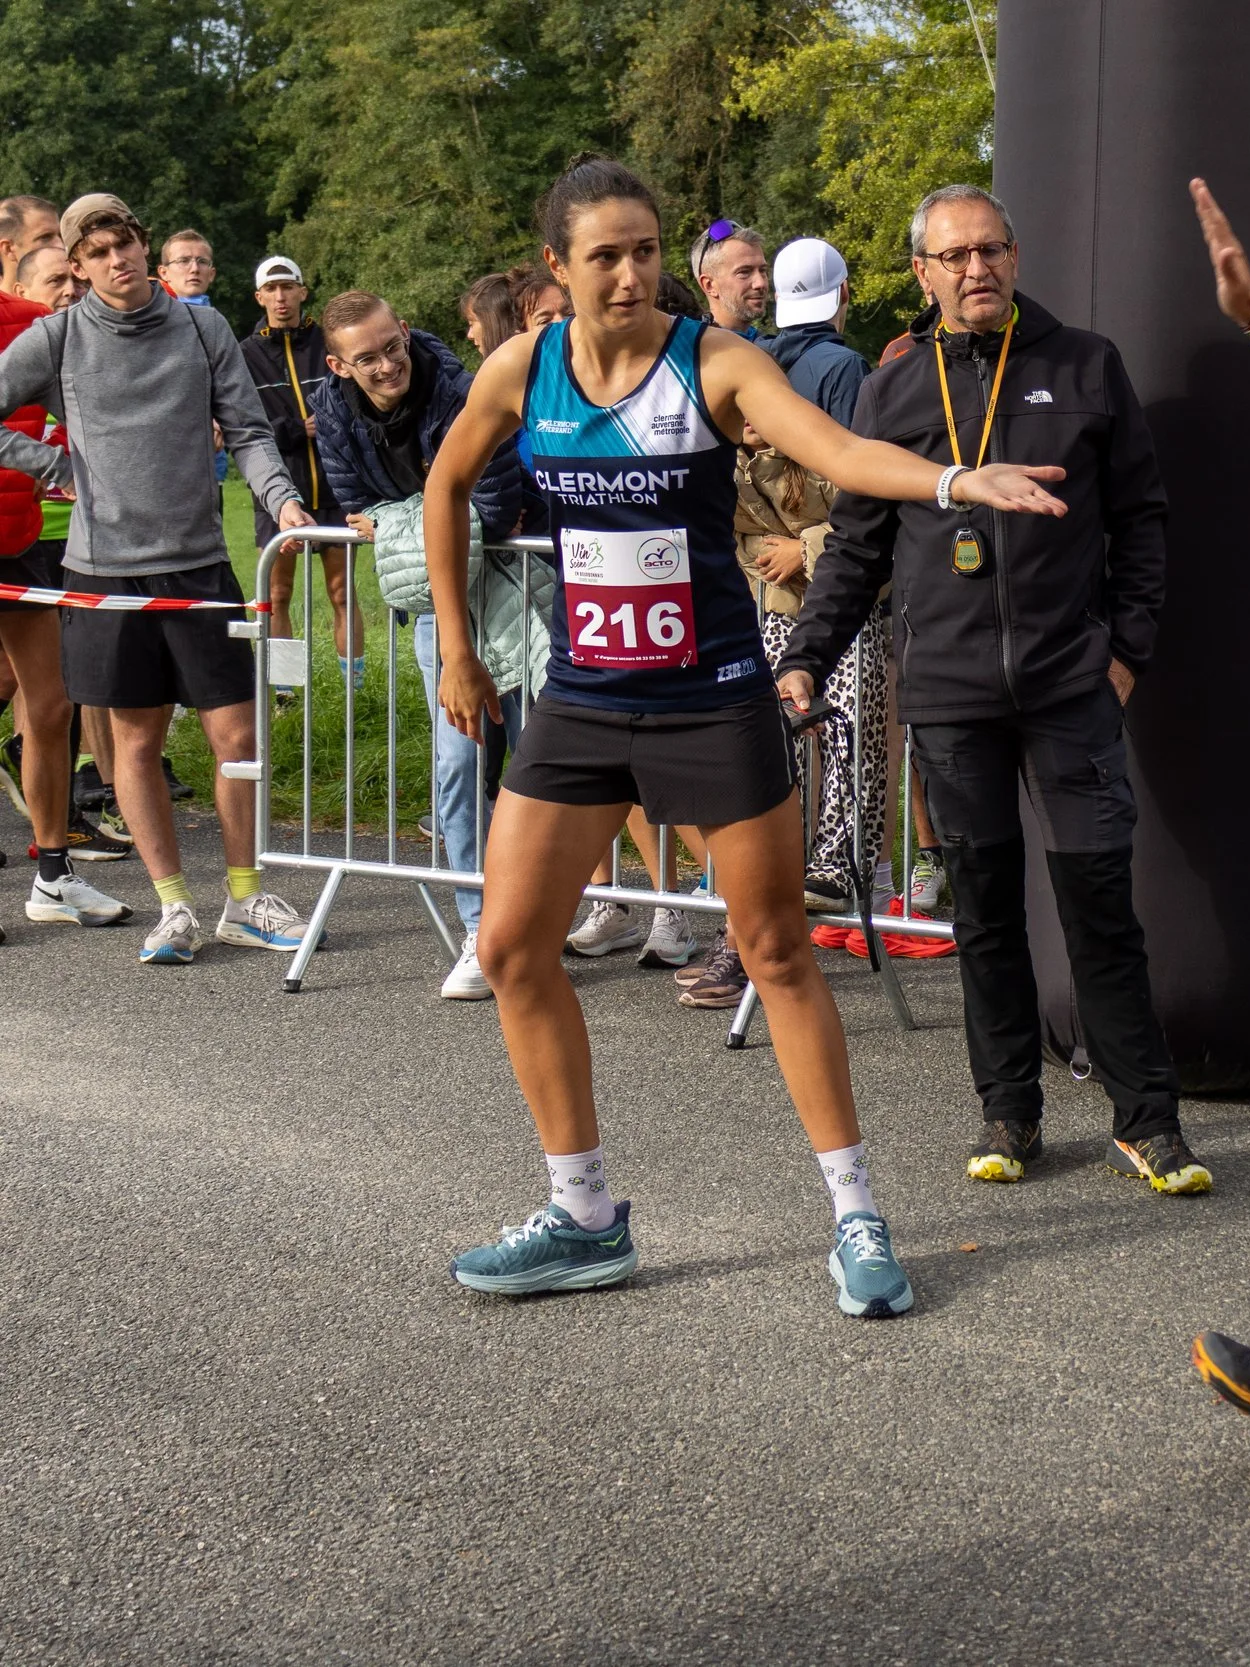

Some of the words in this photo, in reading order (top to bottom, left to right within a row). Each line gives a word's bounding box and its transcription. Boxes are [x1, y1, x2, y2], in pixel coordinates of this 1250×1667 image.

[653, 413, 686, 422] clermont
[545, 420, 580, 429] CLERMONT
[651, 420, 684, 429] auvergne
[653, 426, 690, 435] métropole
[535, 468, 690, 493] CLERMONT
[557, 493, 658, 506] TRIATHLON
[575, 601, 685, 648] 216
